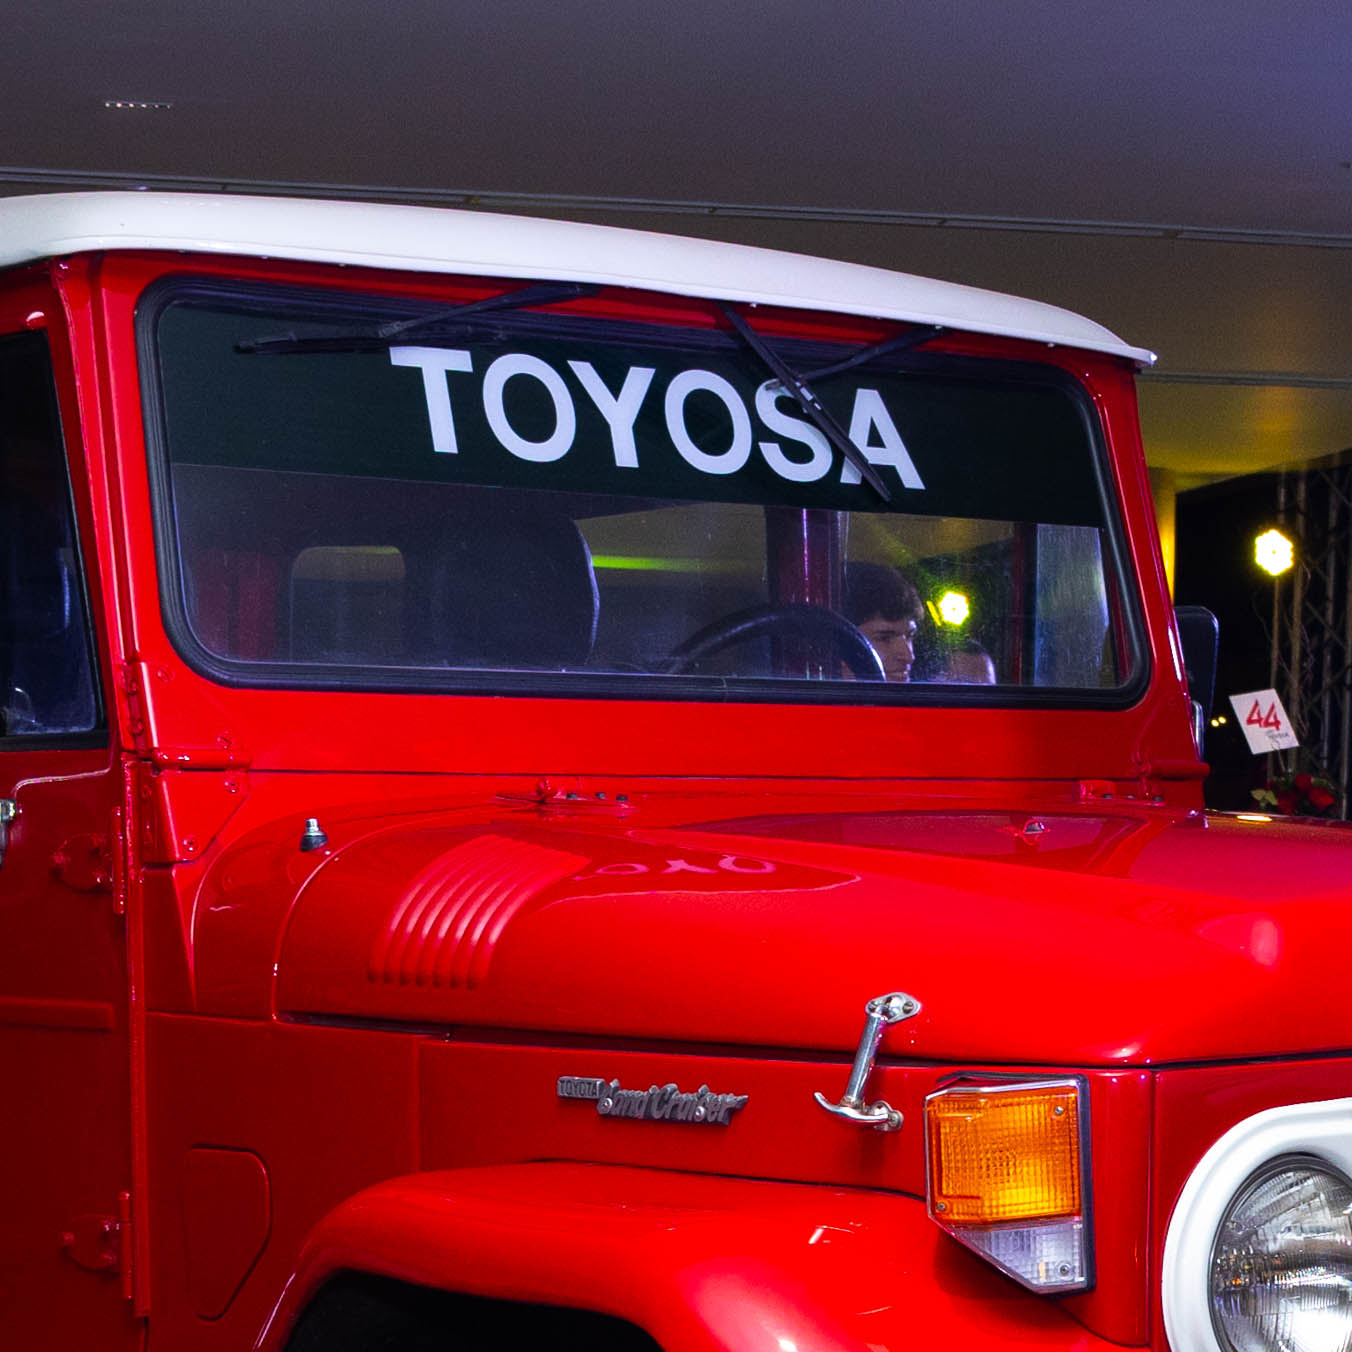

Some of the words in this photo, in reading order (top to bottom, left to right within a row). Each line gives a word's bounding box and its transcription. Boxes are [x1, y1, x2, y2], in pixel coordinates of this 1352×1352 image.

[389, 345, 926, 491] TOYOSA
[1246, 699, 1281, 731] 44
[558, 1078, 600, 1098] TOYOTA
[652, 1083, 748, 1125] Cruiser
